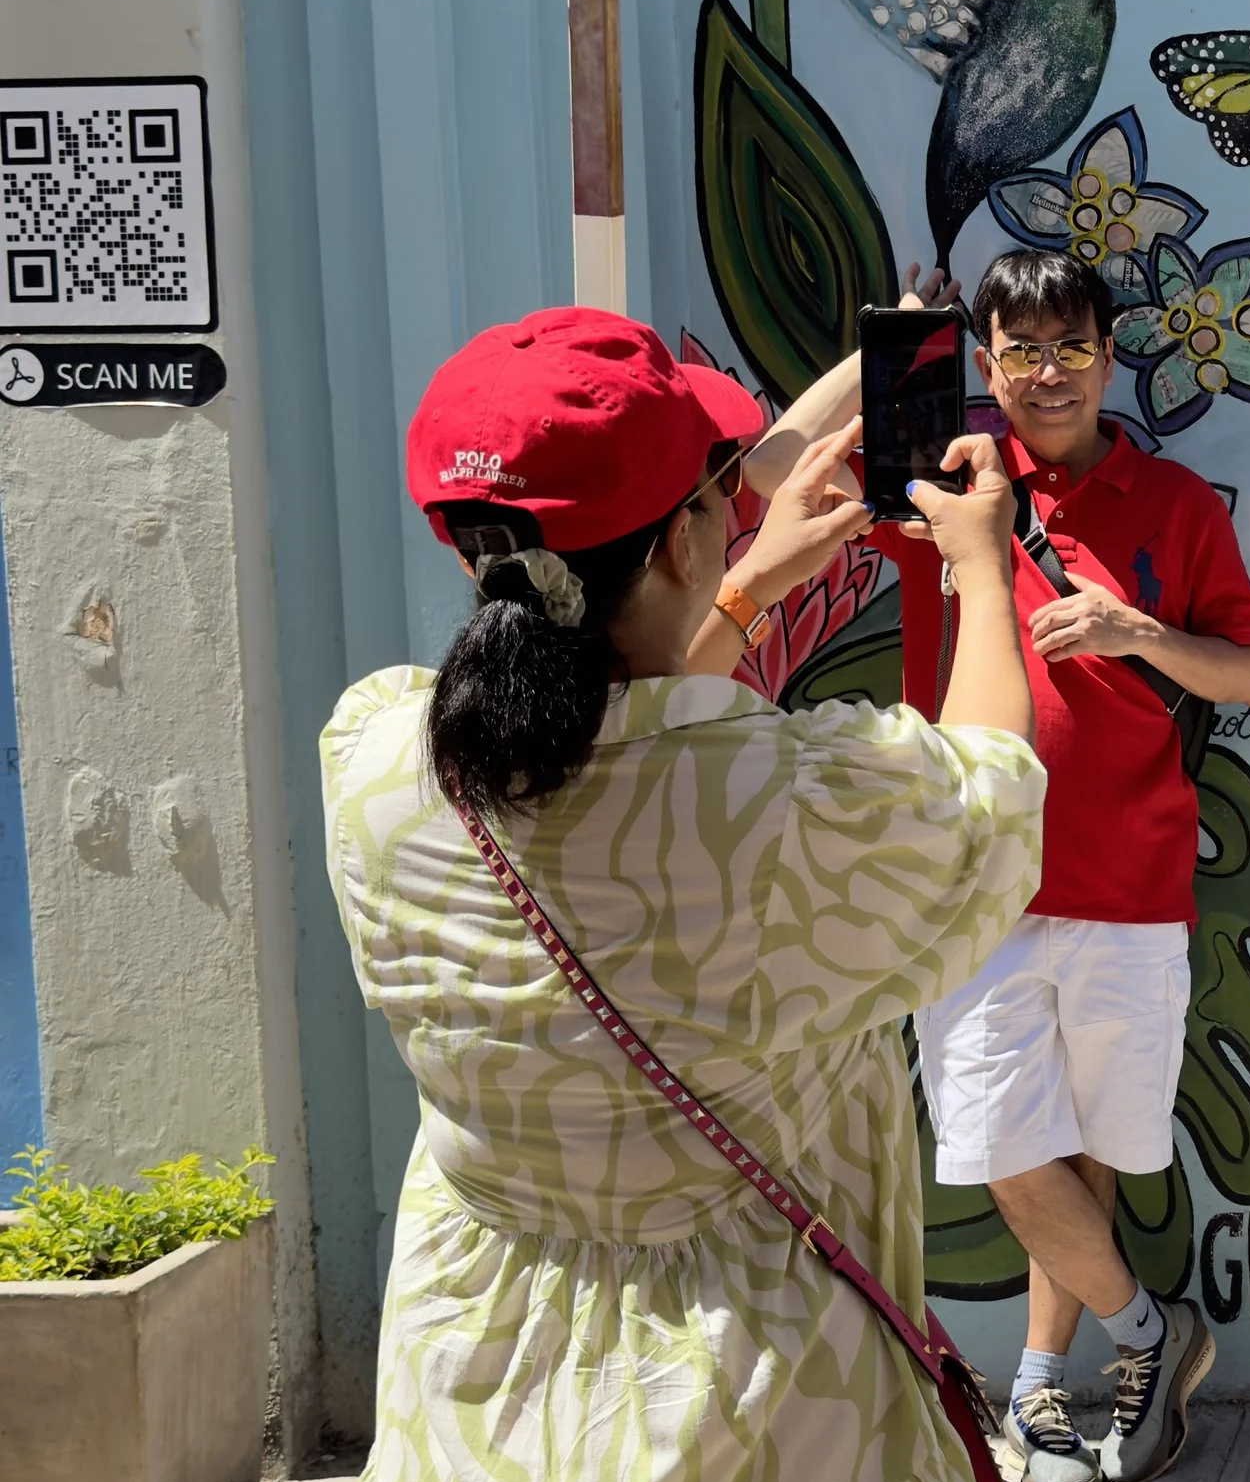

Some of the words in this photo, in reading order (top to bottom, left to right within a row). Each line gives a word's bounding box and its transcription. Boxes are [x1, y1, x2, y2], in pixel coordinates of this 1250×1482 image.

[56, 363, 138, 390] SCAN
[149, 363, 194, 390] ME
[454, 450, 502, 470] POLO
[439, 467, 474, 483] RALPH
[477, 468, 527, 489] LAUREN
